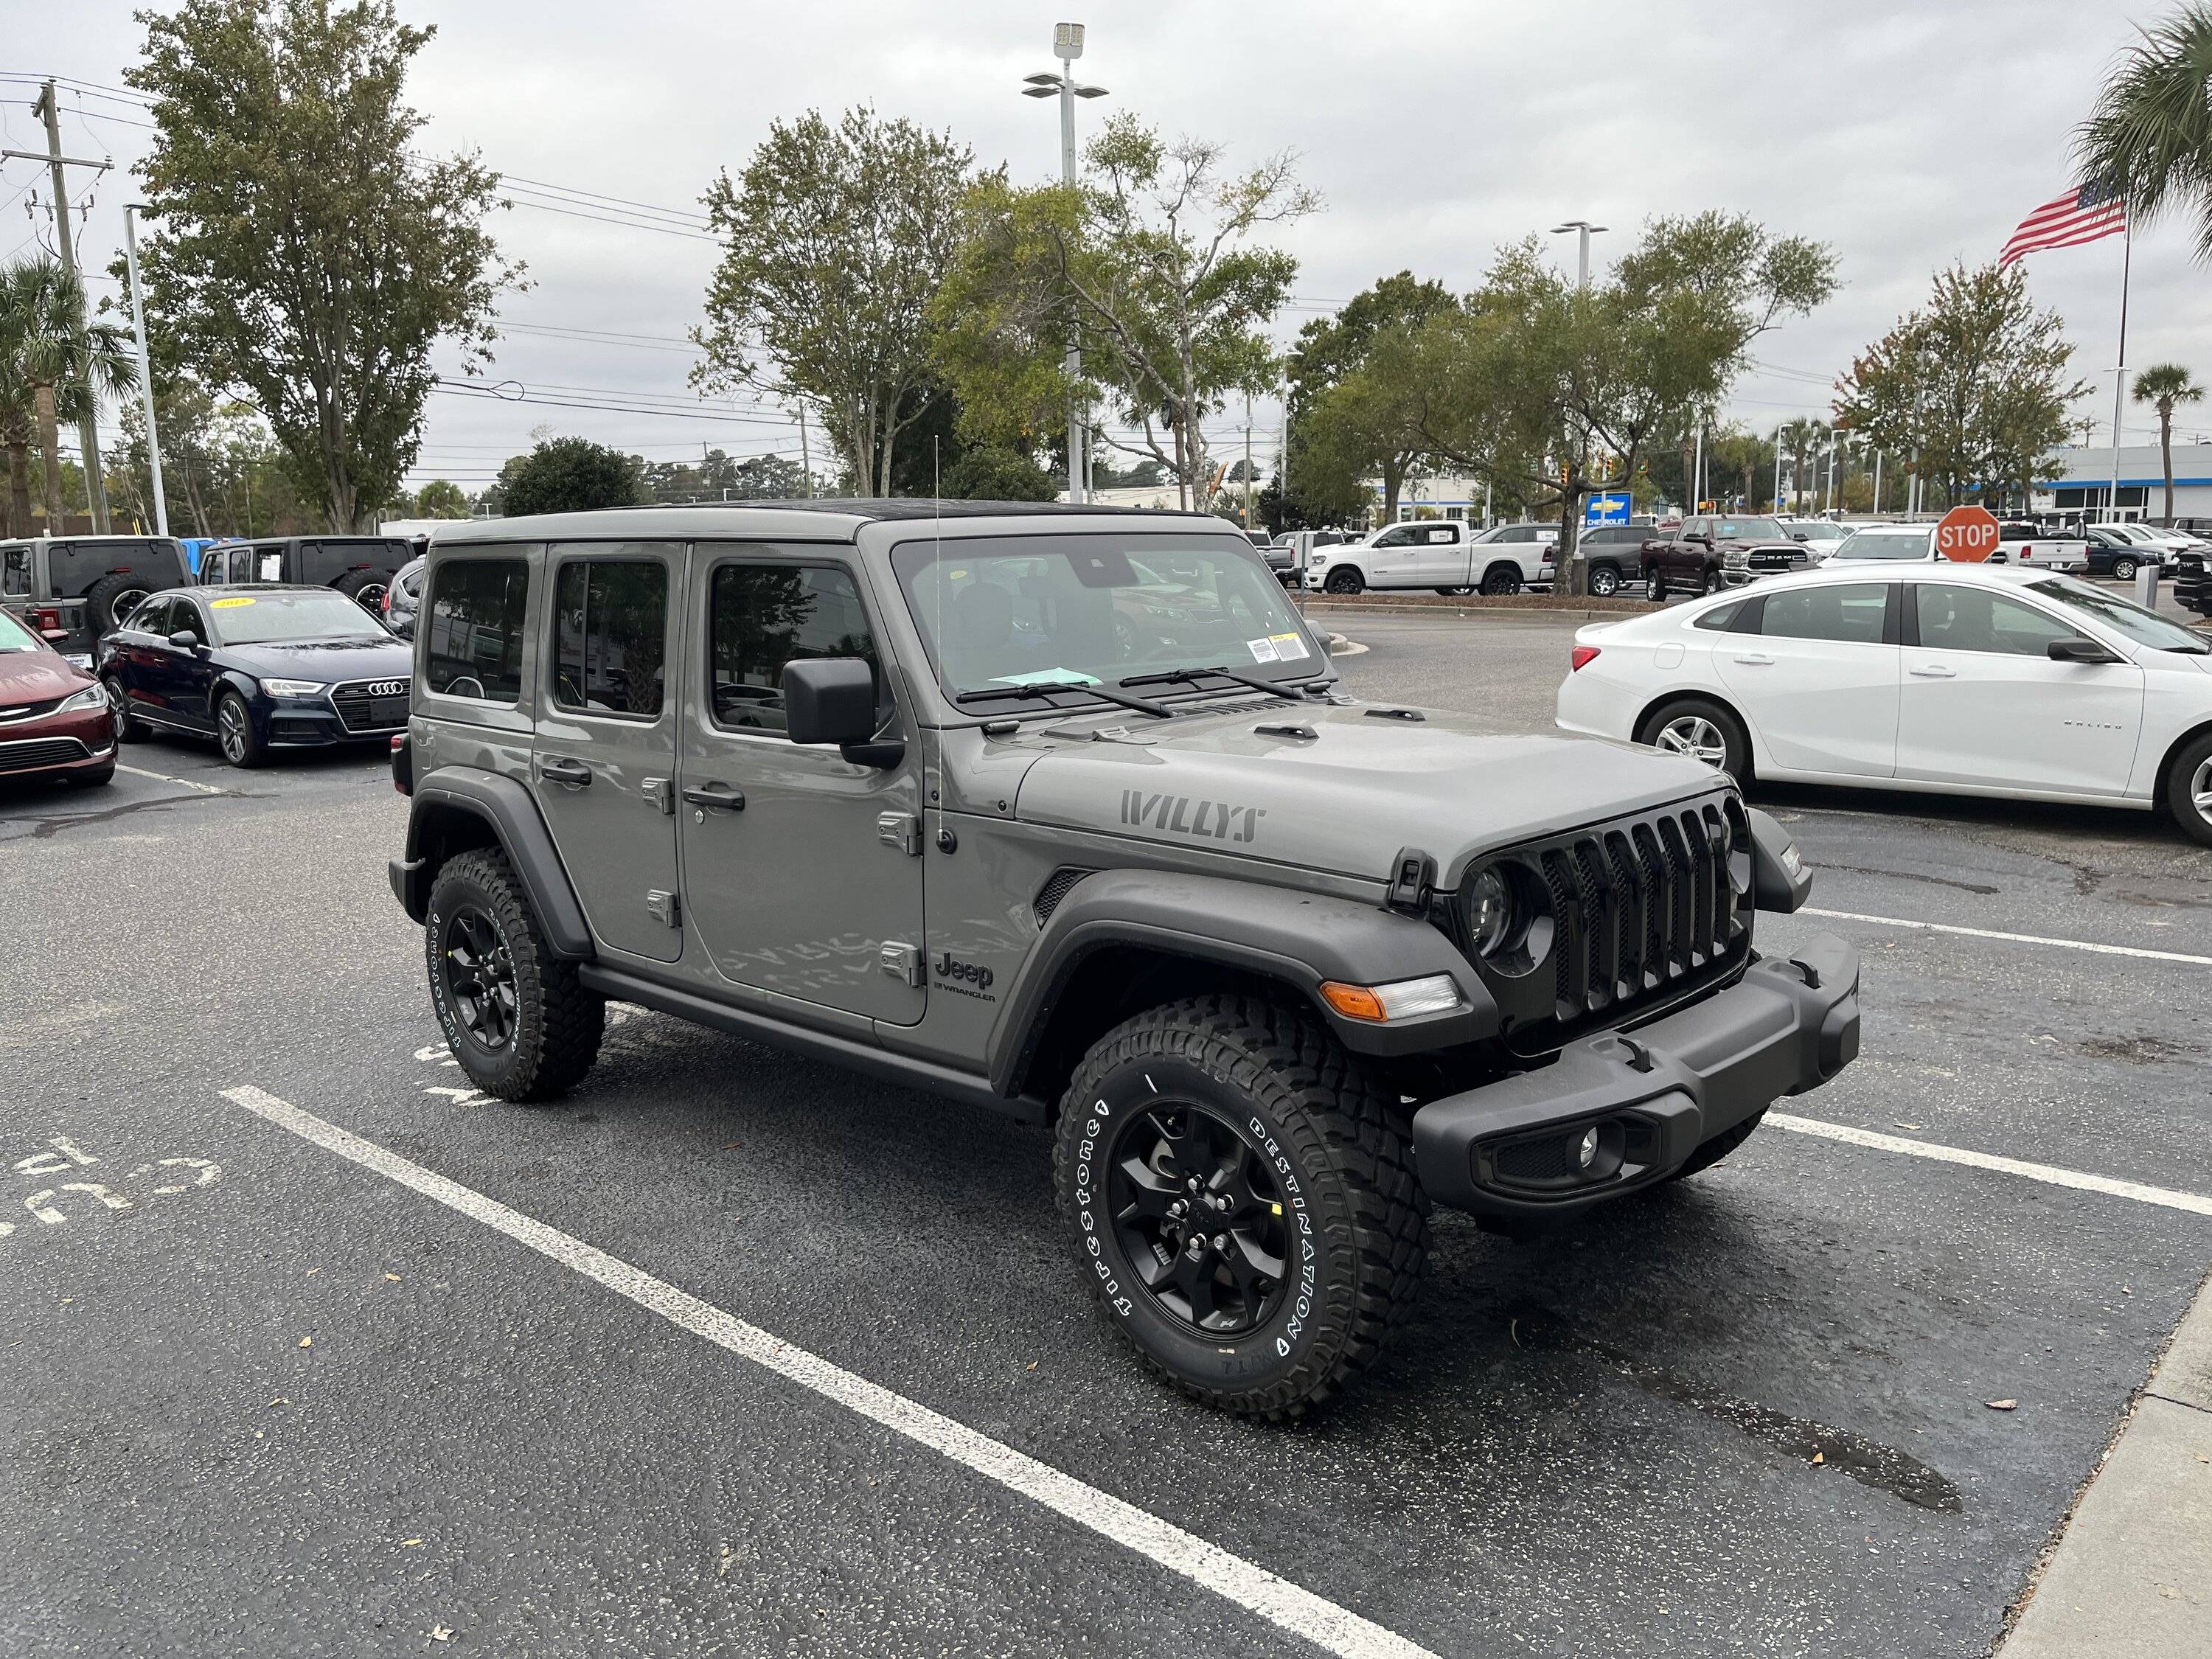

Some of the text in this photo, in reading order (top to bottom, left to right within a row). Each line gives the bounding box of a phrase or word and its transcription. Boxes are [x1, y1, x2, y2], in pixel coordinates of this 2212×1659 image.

[1941, 524, 1994, 548] STOP
[2064, 720, 2122, 730] MALIBU
[1121, 789, 1267, 843] WILLYS
[934, 951, 994, 990] Jeep
[942, 983, 996, 1003] WRANGLER
[1248, 1116, 1315, 1340] DESTINATION
